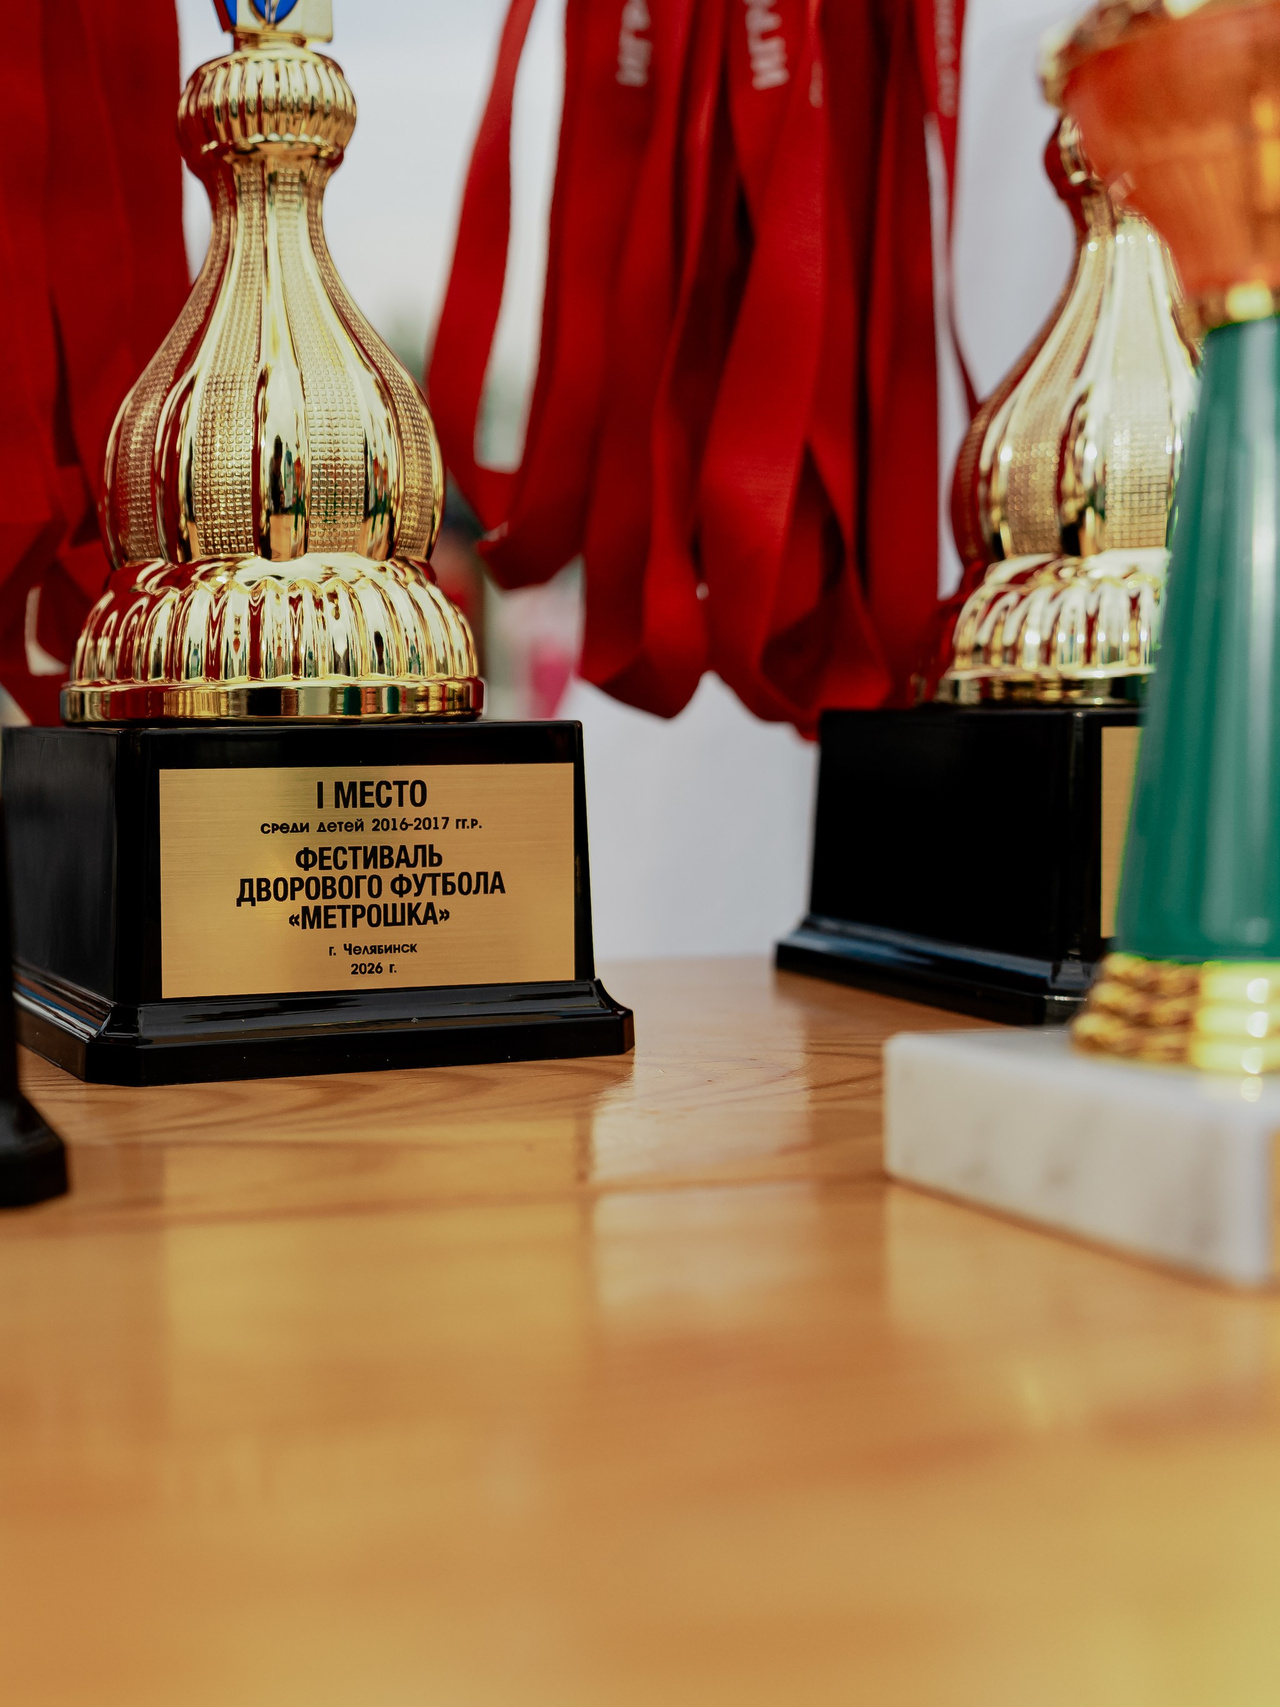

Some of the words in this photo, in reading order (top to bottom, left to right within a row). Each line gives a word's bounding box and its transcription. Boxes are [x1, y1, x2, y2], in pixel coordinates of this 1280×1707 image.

[334, 779, 428, 809] МЕСТО
[260, 821, 310, 834] среди
[316, 817, 365, 833] детей
[371, 816, 450, 831] 2016-2017
[295, 844, 443, 871] ФЕСТИВАЛЬ
[236, 875, 383, 907] ДВОРОВОГО
[390, 871, 506, 898] ФУТБОЛА
[288, 902, 450, 930] «МЕТРОШКА»
[328, 946, 337, 956] г.
[343, 943, 418, 956] Челябинск
[350, 962, 384, 975] 2026
[389, 963, 398, 974] г.
